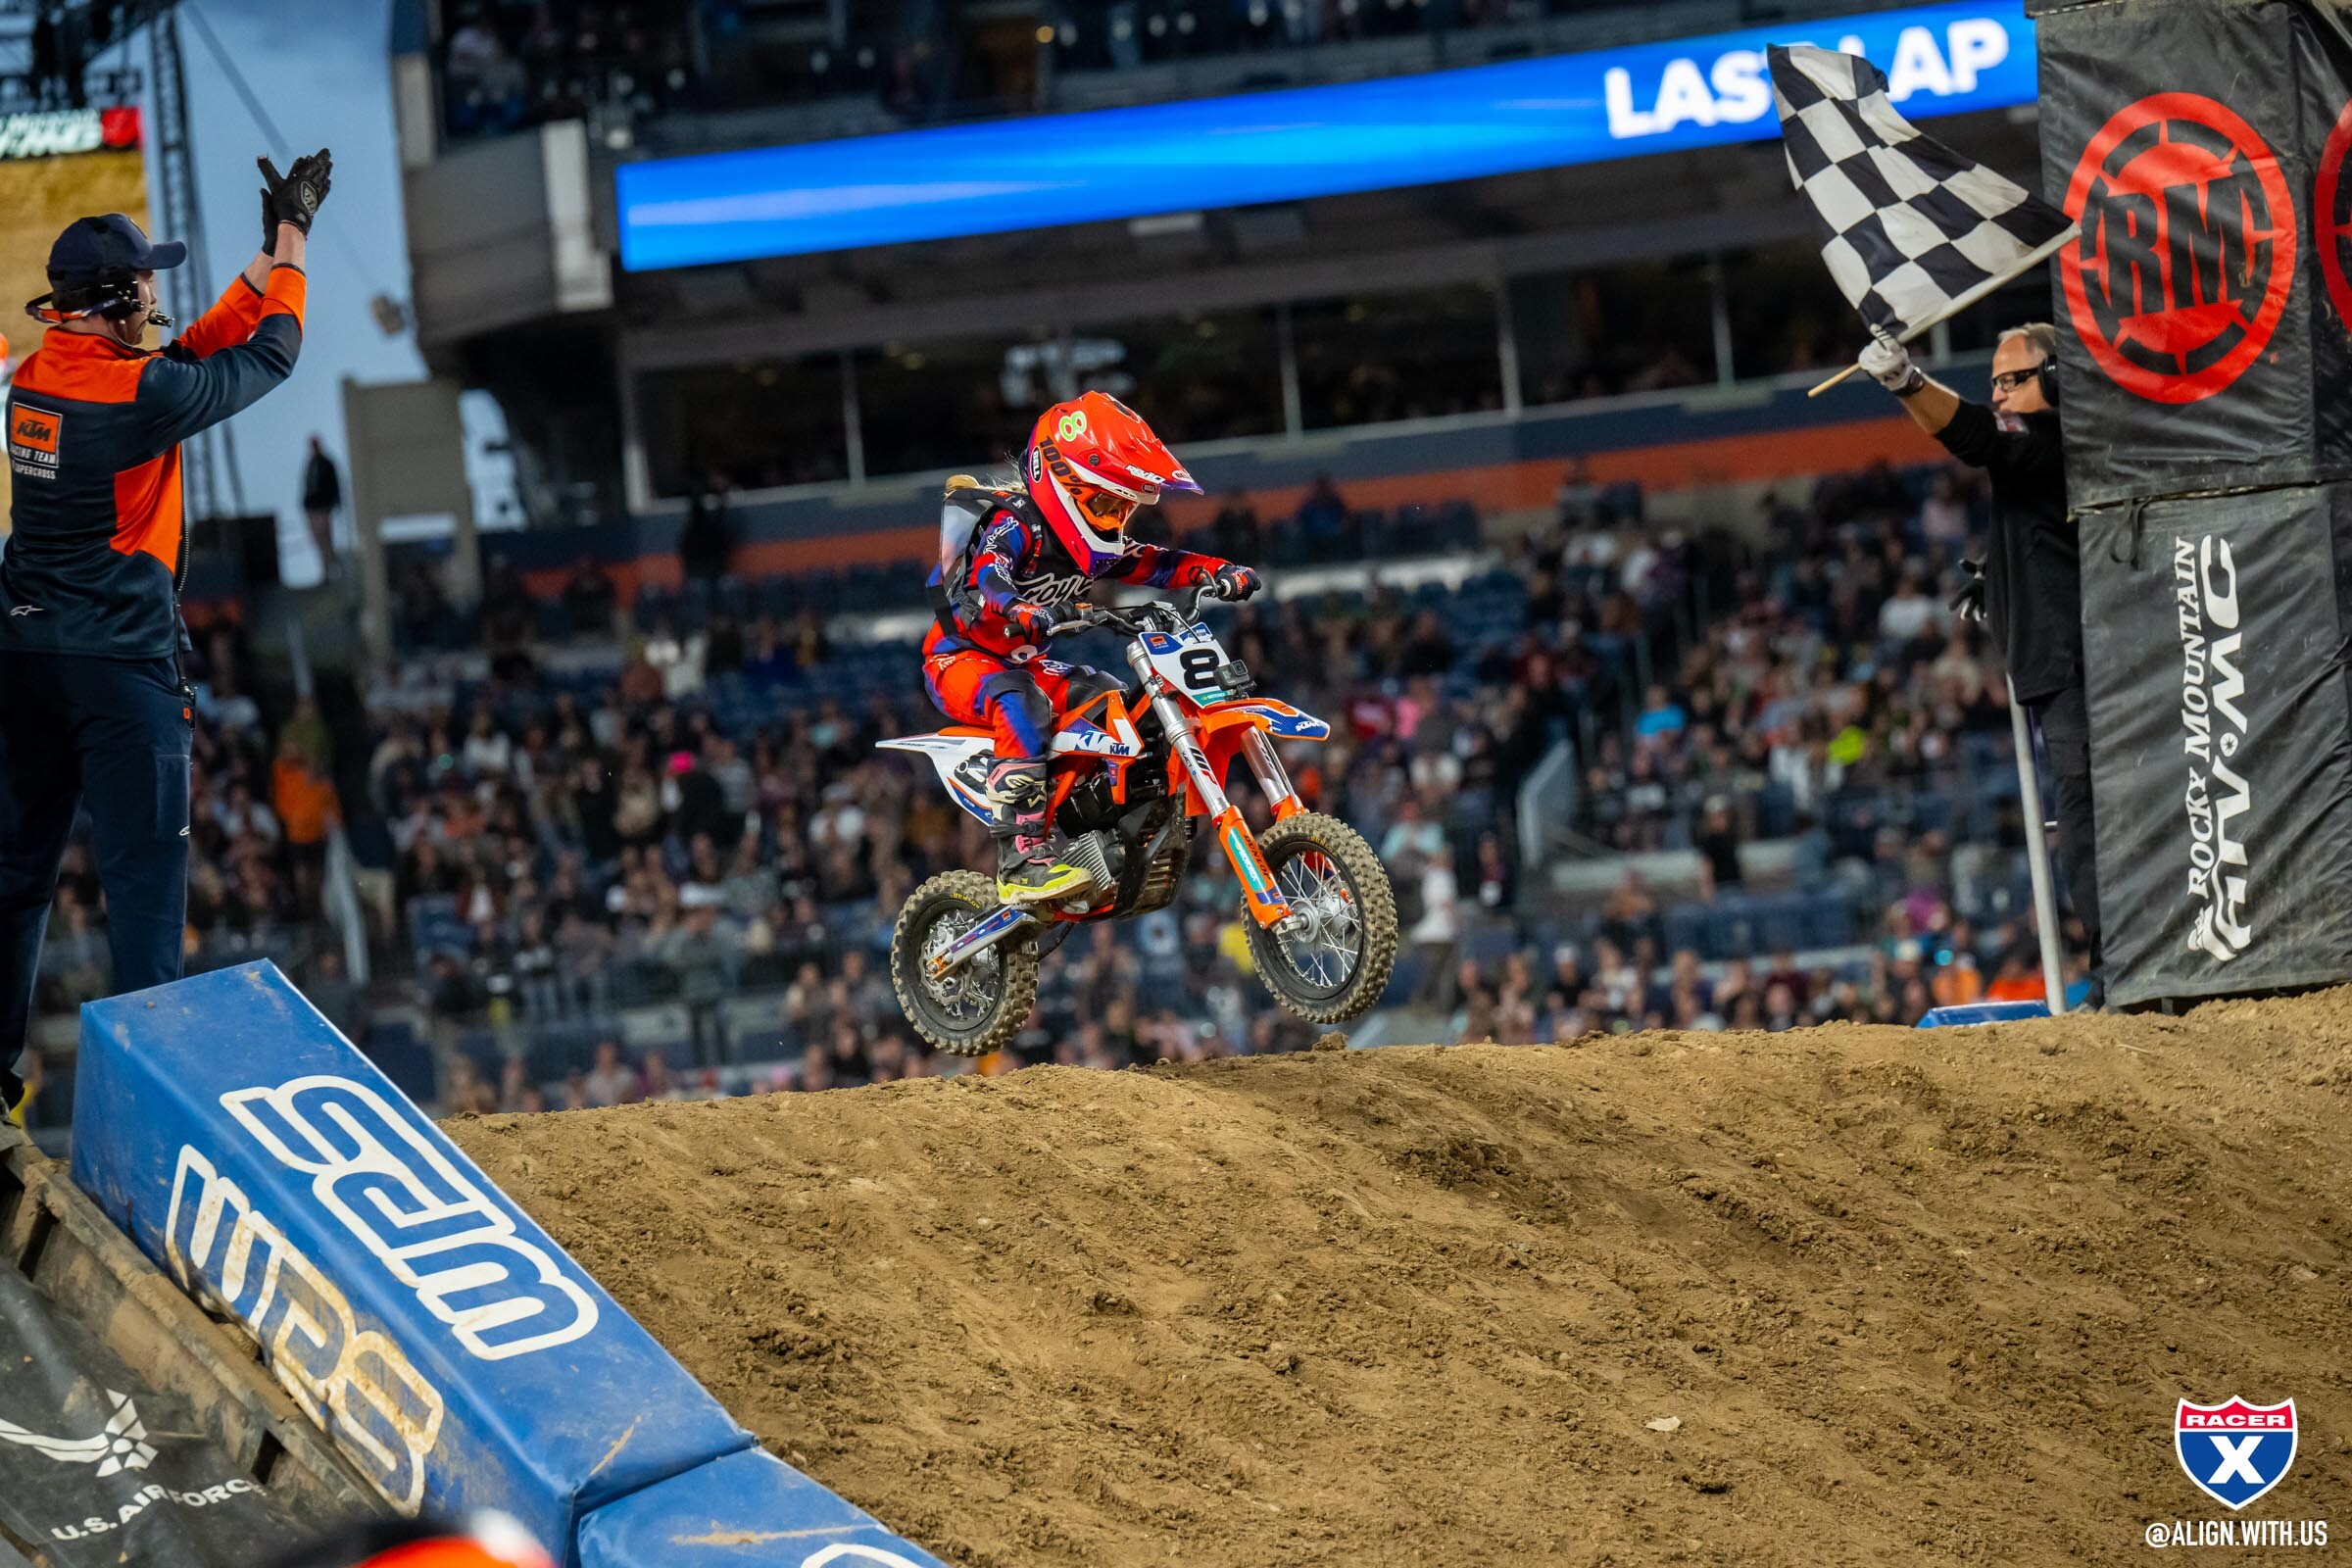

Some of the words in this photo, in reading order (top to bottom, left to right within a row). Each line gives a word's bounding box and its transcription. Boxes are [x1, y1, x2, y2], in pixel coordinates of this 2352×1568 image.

[17, 419, 52, 441] KTM
[1058, 411, 1087, 441] 8
[1032, 450, 1041, 479] BELL
[1040, 436, 1088, 495] 100%
[1179, 648, 1220, 690] 8
[2174, 535, 2211, 763] MOUNTAIN
[1109, 742, 1130, 756] KTM
[2186, 766, 2215, 900] ROCKY
[1244, 834, 1271, 881] DUNLOP
[220, 1075, 599, 1360] WPS
[51, 1517, 118, 1541] U.S.
[118, 1484, 169, 1525] AIR
